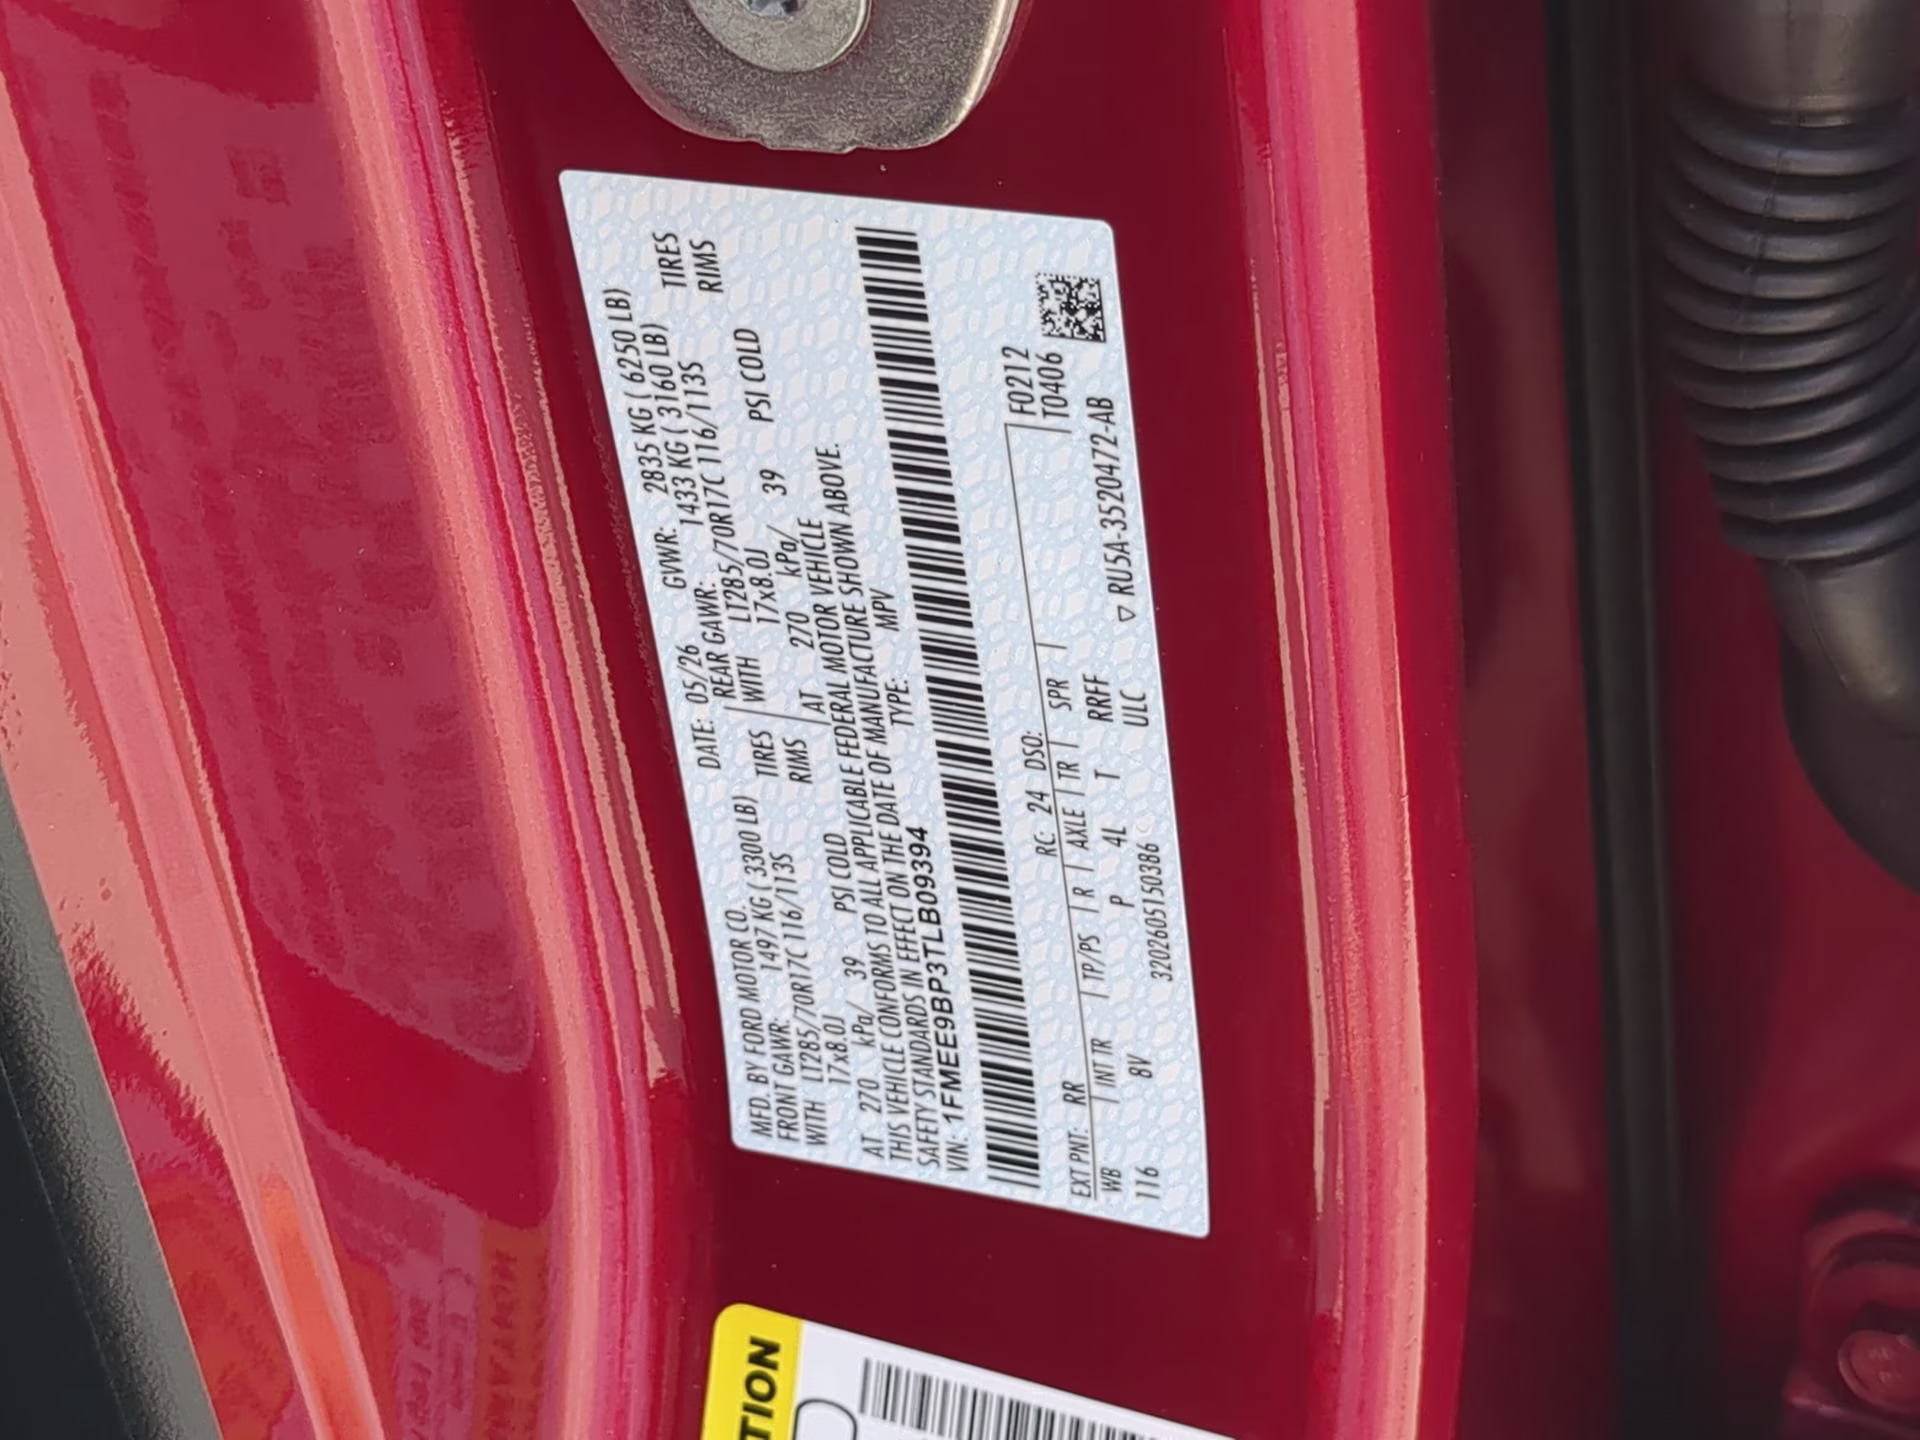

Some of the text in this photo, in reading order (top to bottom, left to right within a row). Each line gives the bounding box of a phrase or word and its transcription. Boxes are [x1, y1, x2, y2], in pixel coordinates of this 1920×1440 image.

[602, 288, 633, 322] LB)
[611, 329, 645, 383] 6250
[640, 323, 670, 357] LB)
[648, 364, 682, 419] 3160
[1001, 346, 1037, 416] F0212
[1035, 352, 1070, 418] T0406
[627, 407, 656, 435] KG
[689, 240, 780, 624] 17x8.0J RIMS
[634, 442, 669, 494] 2835
[652, 232, 765, 702] WITH LT285/70R17C 116/113S TIRES
[664, 441, 693, 469] KG
[671, 476, 704, 525] 1433
[733, 328, 826, 714] AT 270 kPa/ 39 PSI COLD
[1086, 397, 1135, 596] RU5A-3520472-AB
[654, 527, 687, 589] GVWR:
[694, 582, 726, 645] GAWR:
[705, 651, 736, 699] REAR
[869, 588, 914, 726] TYPE: MPV
[676, 645, 721, 769] DATE: 05/26
[1046, 678, 1072, 711] SPR
[1082, 674, 1113, 722] RRFF
[1120, 690, 1149, 727] ULC
[1021, 731, 1057, 857] RC: 24 DSO:
[1056, 761, 1080, 779] TR
[1094, 769, 1120, 779] T
[732, 796, 758, 825] LB)
[815, 444, 940, 1168] SAFETY STANDARDS IN EFFECT ON THE DATE OF MANUFACTURE SHOWN ABOVE.
[1062, 807, 1089, 851] AXLE
[738, 830, 767, 877] 3300
[797, 518, 912, 1161] THIS VEHICLE CONFORMS TO ALL APPLICABLE FEDERAL MOTOR VEHICLE
[1101, 827, 1127, 847] 4L
[749, 897, 774, 922] KG
[782, 738, 851, 1084] 17x8.0J RIMS
[1072, 887, 1094, 898] R
[1109, 895, 1135, 908] P
[1136, 843, 1173, 982] 3202605150386
[748, 730, 830, 1145] WITH LT285/70R17C 116/113S TIRES
[754, 927, 782, 971] 1497
[1077, 934, 1105, 980] TP/PS
[724, 906, 772, 1137] MFD. BY FORD MOTOR CO.
[823, 833, 884, 1159] AT 270 kPa/ 39 PSI COLD
[905, 827, 968, 1171] VIN: 1FMEE9BP3TLB09394
[768, 1018, 794, 1076] GAWR:
[1091, 1038, 1115, 1087] INT TR
[1127, 1054, 1153, 1079] 8V
[774, 1082, 799, 1142] FRONT
[1062, 1081, 1094, 1198] EXT PNT: RR
[1100, 1167, 1122, 1192] WB
[1136, 1167, 1160, 1199] 116
